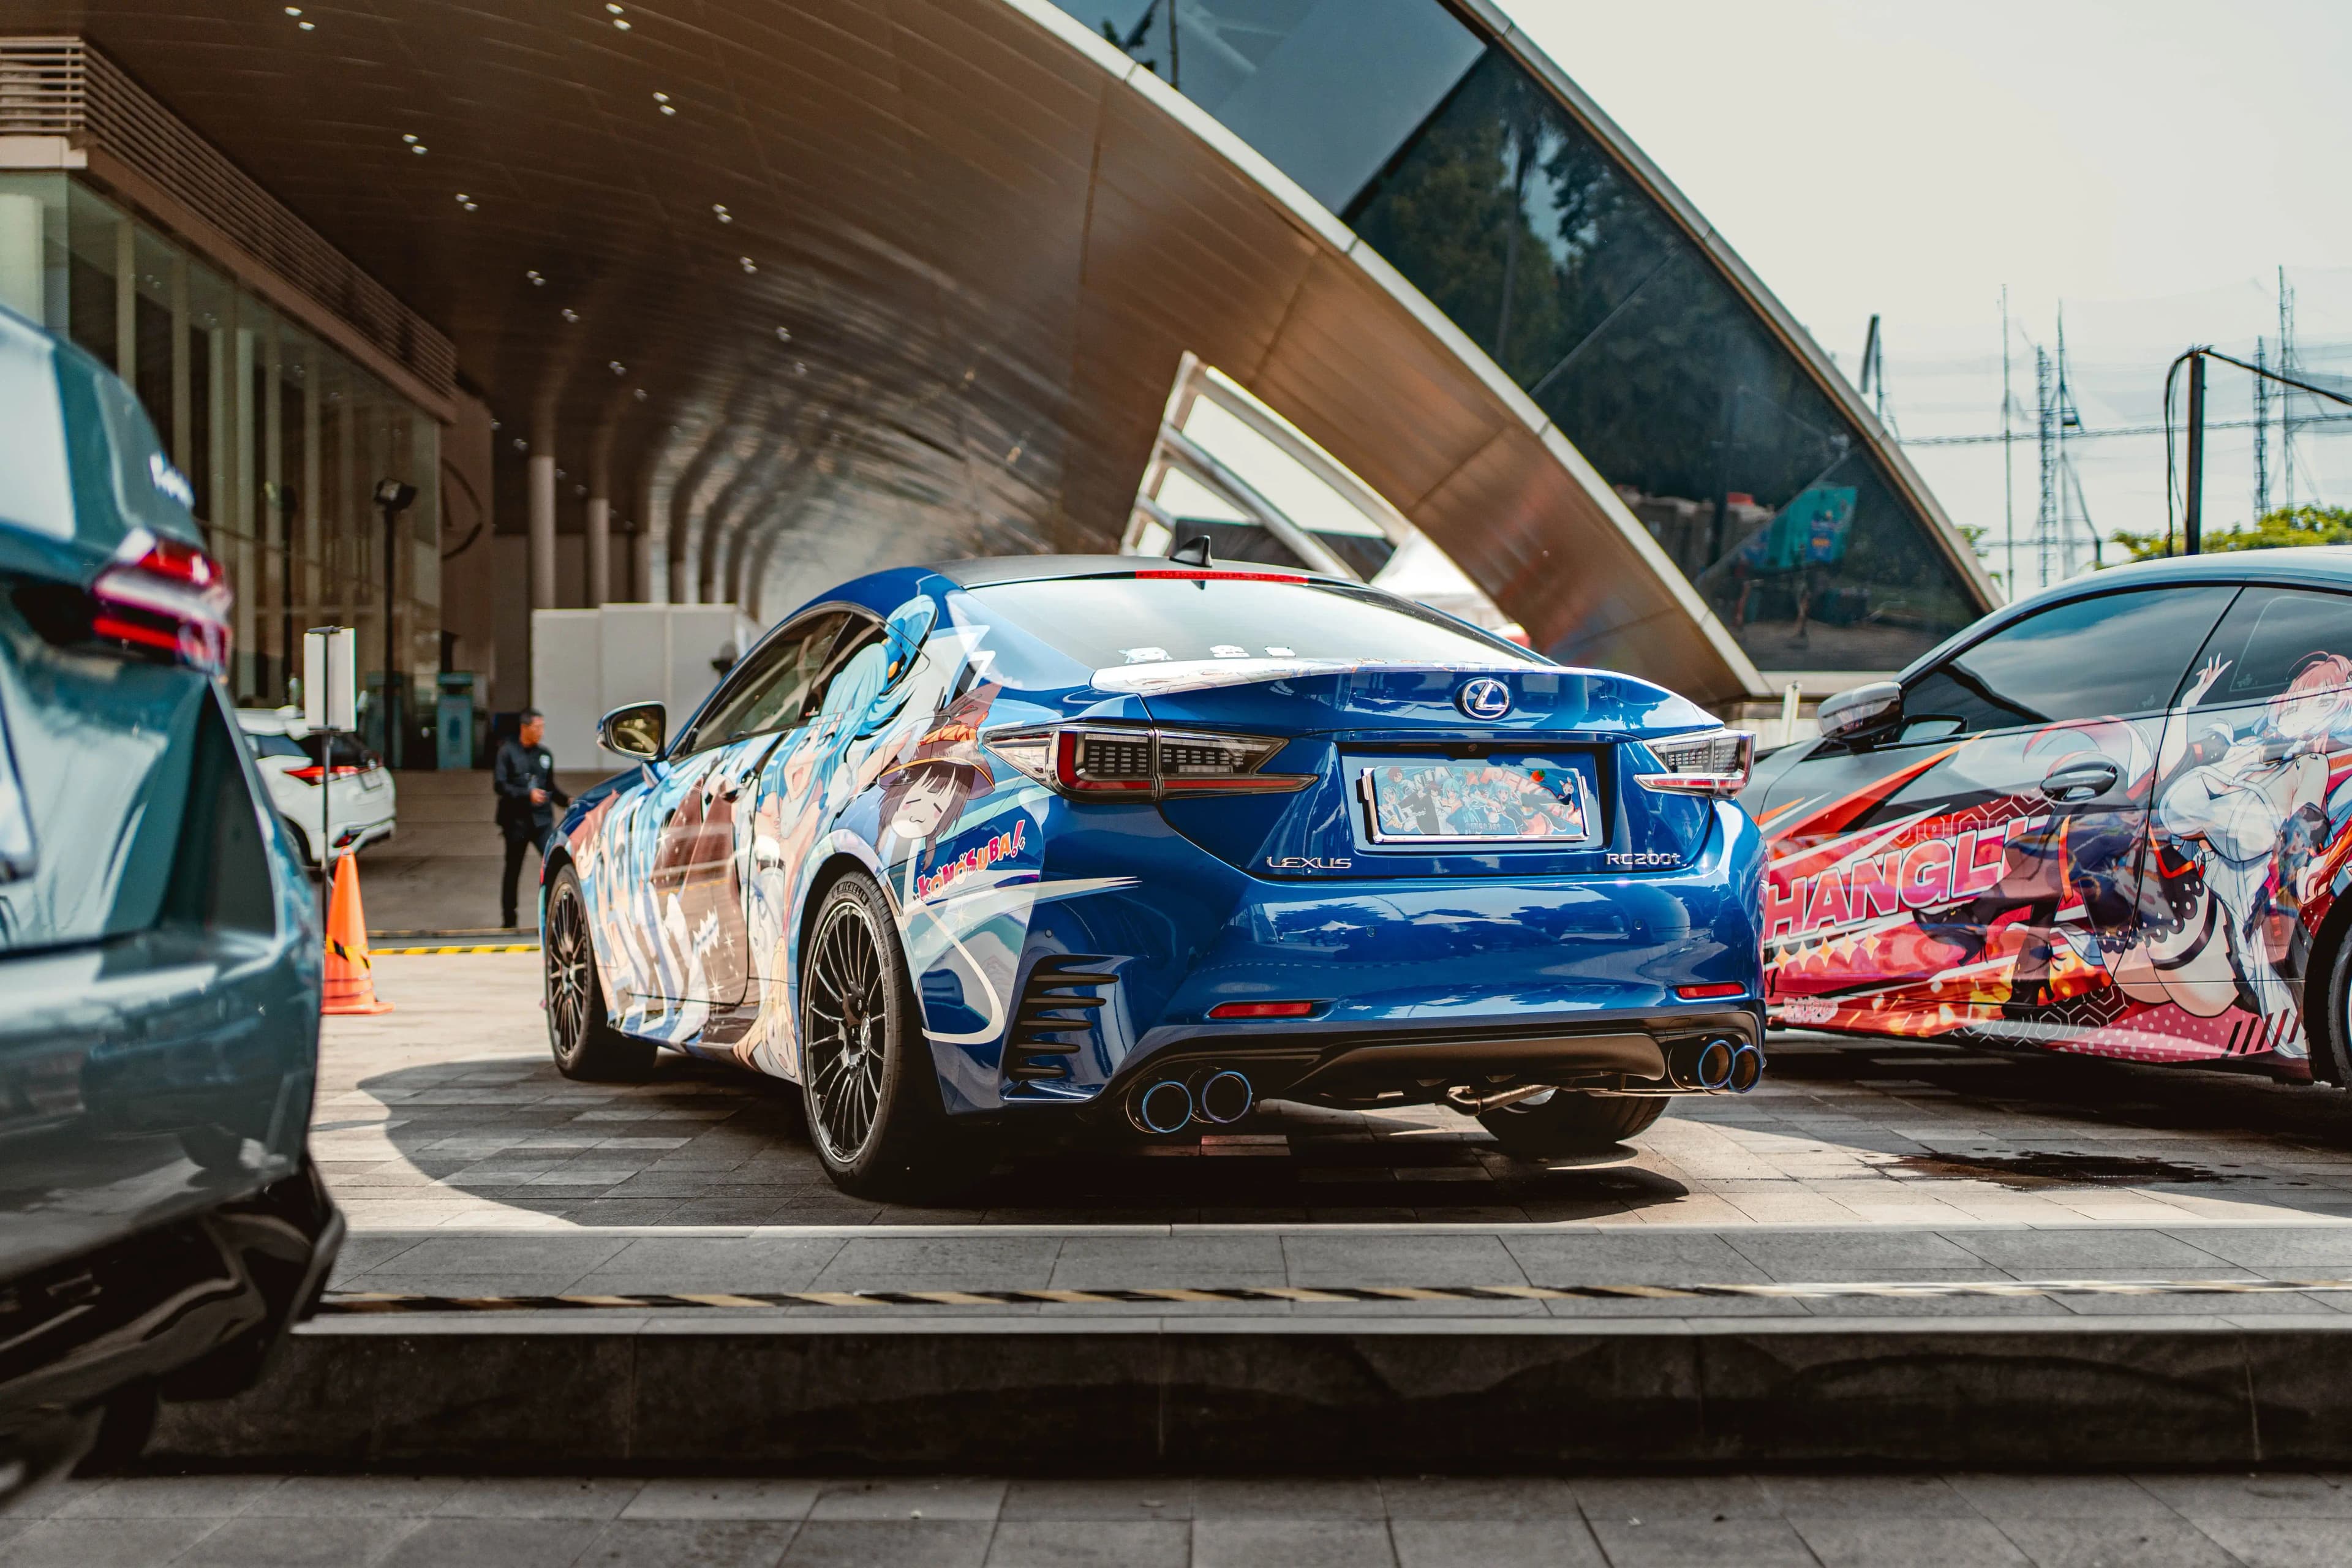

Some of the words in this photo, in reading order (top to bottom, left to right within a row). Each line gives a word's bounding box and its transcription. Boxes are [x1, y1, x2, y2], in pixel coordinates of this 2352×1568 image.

[917, 820, 1026, 901] KONOSUBA!
[1266, 856, 1352, 869] LEXUS
[1606, 853, 1681, 865] RC200t
[838, 882, 868, 903] MICHELIN
[869, 903, 878, 920] PILOT
[875, 921, 884, 944] SPORT
